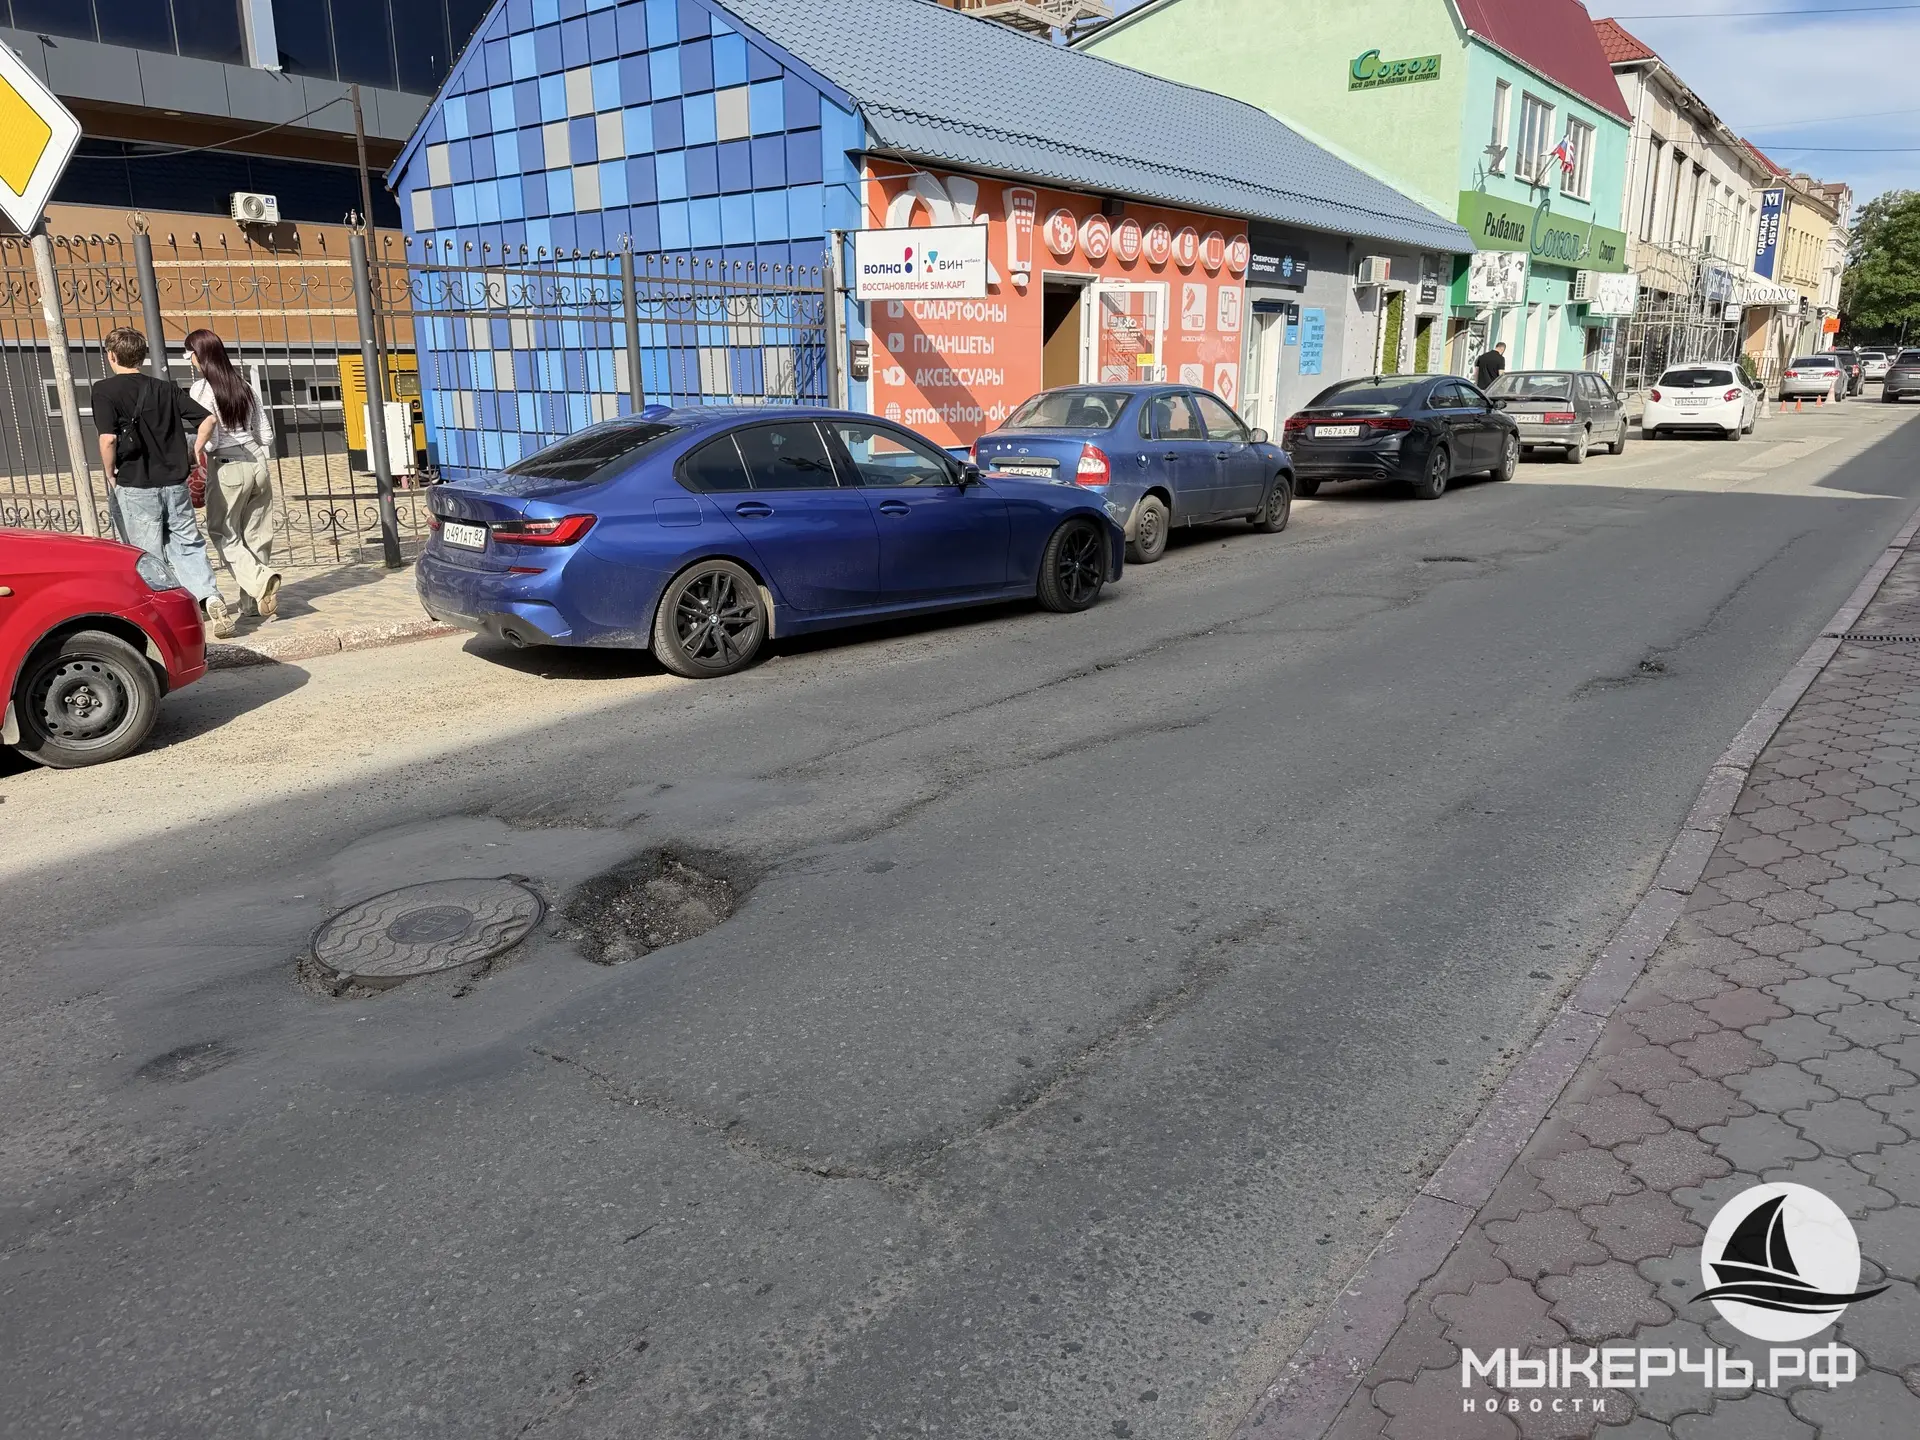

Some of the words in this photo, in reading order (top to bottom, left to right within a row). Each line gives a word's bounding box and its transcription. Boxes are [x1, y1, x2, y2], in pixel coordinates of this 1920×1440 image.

[1353, 49, 1437, 80] Сокол
[1377, 76, 1407, 87] рыбалки
[1414, 72, 1438, 80] спорта
[1483, 211, 1525, 243] Рыбалка
[1530, 198, 1581, 262] Сокол
[1757, 213, 1770, 256] ОДЕЖДА
[1767, 213, 1779, 246] ОБУВЬ
[1598, 240, 1617, 264] Спорт
[862, 281, 929, 292] ВОССТАНОВЛЕНИЕ
[930, 280, 966, 290] SIM-КАРТ
[913, 300, 1007, 323] СМАРТФОНЫ
[913, 333, 995, 355] ПЛАНШЕТЫ
[914, 367, 1004, 387] АКСЕССУАРЫ
[446, 524, 472, 544] О491АТ
